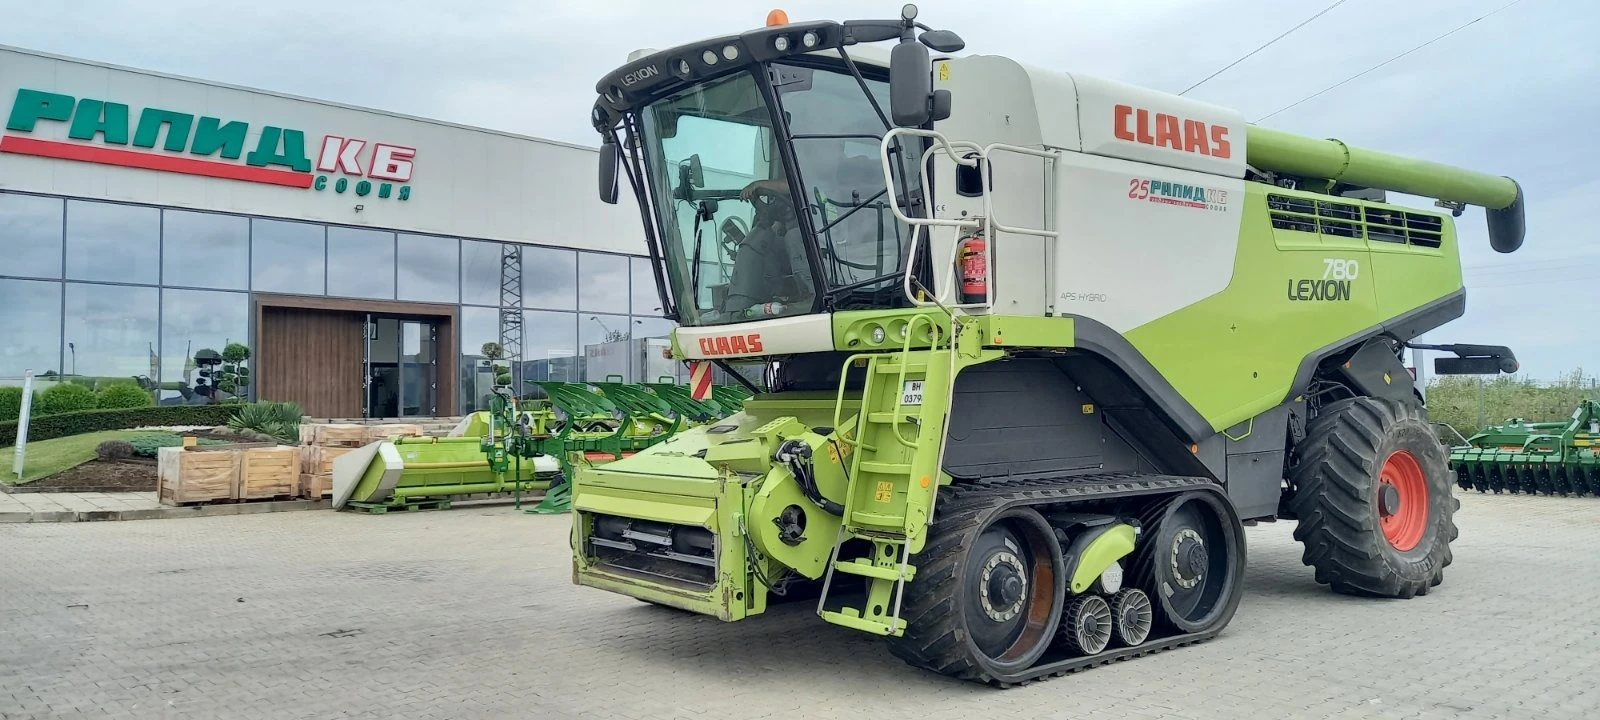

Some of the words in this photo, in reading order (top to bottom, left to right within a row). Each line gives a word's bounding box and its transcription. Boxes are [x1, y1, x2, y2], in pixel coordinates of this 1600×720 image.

[620, 65, 658, 86] LEXION
[7, 88, 311, 172] РАПИД
[317, 135, 416, 181] КБ
[1115, 104, 1230, 158] CLAAS
[314, 175, 411, 201] СОФИЯ
[1129, 179, 1150, 199] 25
[1150, 180, 1206, 202] РАПИД
[1323, 258, 1359, 280] 780
[1060, 292, 1077, 301] APS
[1078, 293, 1107, 302] HYBRID
[1288, 279, 1351, 301] LEXION
[699, 334, 763, 356] CLAAS
[904, 394, 923, 403] 0379
